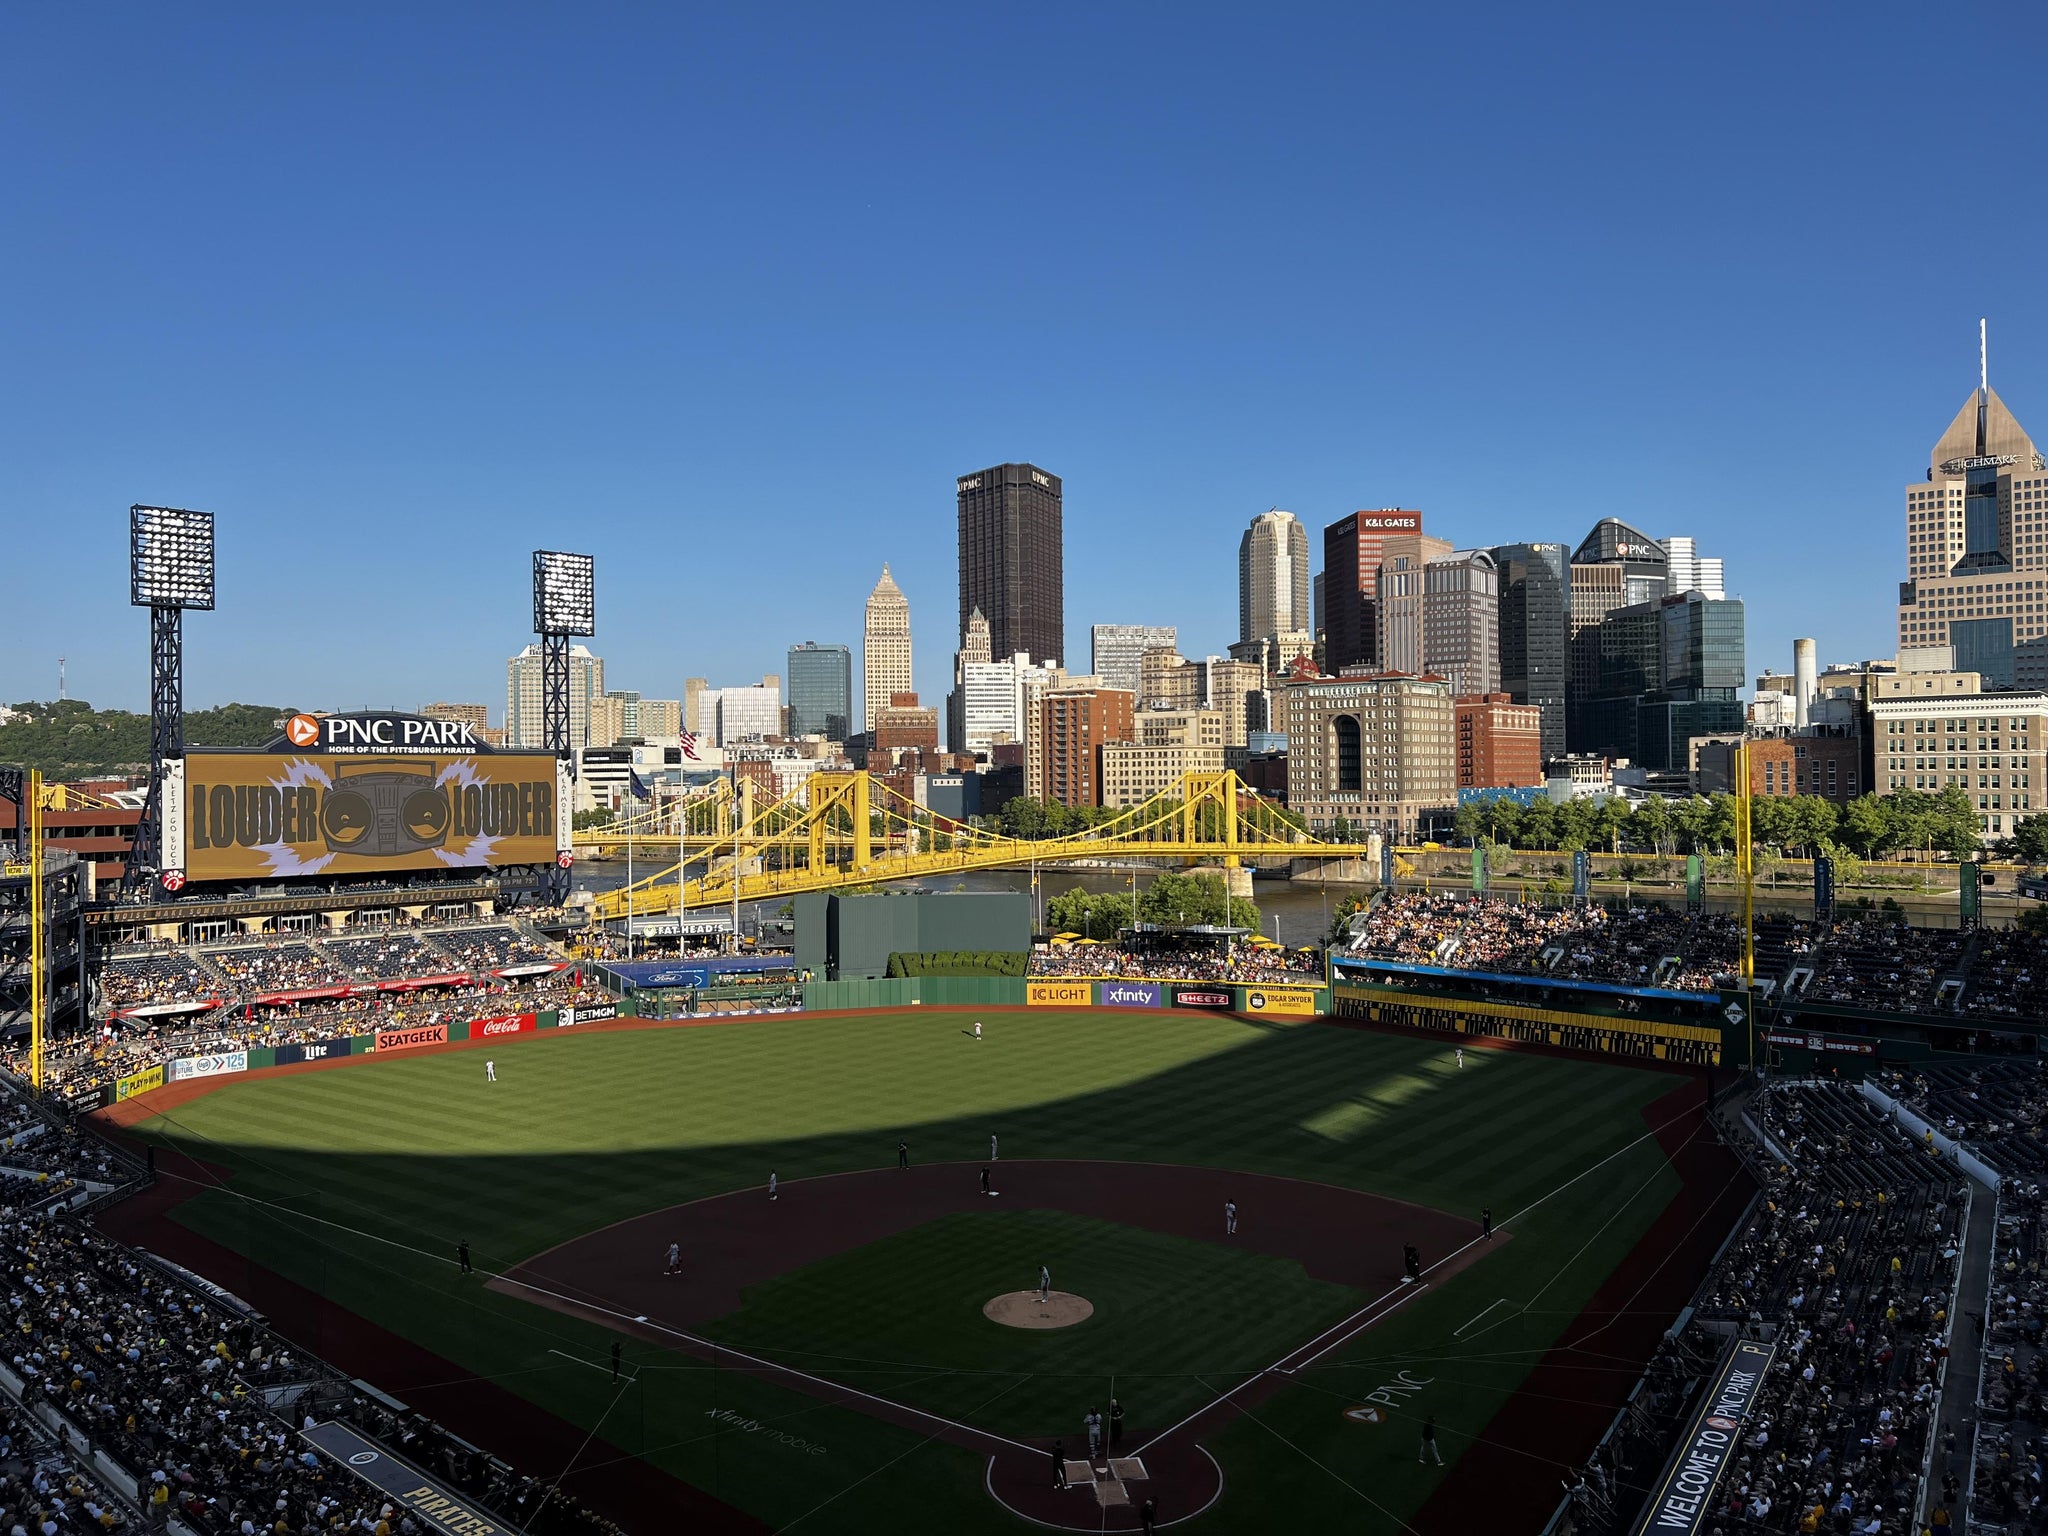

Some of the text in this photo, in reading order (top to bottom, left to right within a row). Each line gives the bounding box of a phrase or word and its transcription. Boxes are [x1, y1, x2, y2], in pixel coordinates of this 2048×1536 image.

[957, 477, 981, 492] UPMC
[1032, 471, 1050, 488] UPMC
[1365, 518, 1415, 527] K&L GATES
[1541, 544, 1557, 552] PNC
[1628, 544, 1650, 555] PNC
[324, 718, 477, 745] PNC PARK
[328, 746, 356, 754] HOME
[356, 746, 369, 754] OF
[370, 746, 388, 754] THE
[389, 746, 442, 754] PITTSBURGH
[192, 784, 318, 850] LOUDER
[453, 781, 552, 837] LOUDER
[658, 924, 724, 935] FAT HEAD'S
[1032, 988, 1086, 1000] IC LIGHT
[1109, 988, 1153, 1004] xfinity
[1181, 994, 1225, 1004] SHEETZ
[1267, 994, 1288, 1003] EDGAR
[1288, 995, 1312, 1004] SNYDER
[575, 1007, 615, 1021] BETMGM
[379, 1028, 443, 1049] SEATGEEK
[1494, 1016, 1518, 1026] SOME
[1524, 1020, 1553, 1031] NOISE
[1560, 1025, 1585, 1035] MAKE
[1591, 1029, 1618, 1039] SOME
[1625, 1033, 1657, 1044] NOISE
[1664, 1037, 1694, 1049] MAKE
[226, 1053, 245, 1068] 125
[304, 1045, 328, 1061] Lite
[129, 1078, 145, 1093] PLAY
[149, 1073, 162, 1085] WIN!
[1363, 1370, 1435, 1408] PNC
[704, 1407, 827, 1456] xfinity mobile
[1656, 1369, 1757, 1529] WELCOME TO PNC PARK
[402, 1486, 496, 1536] PIRATES
